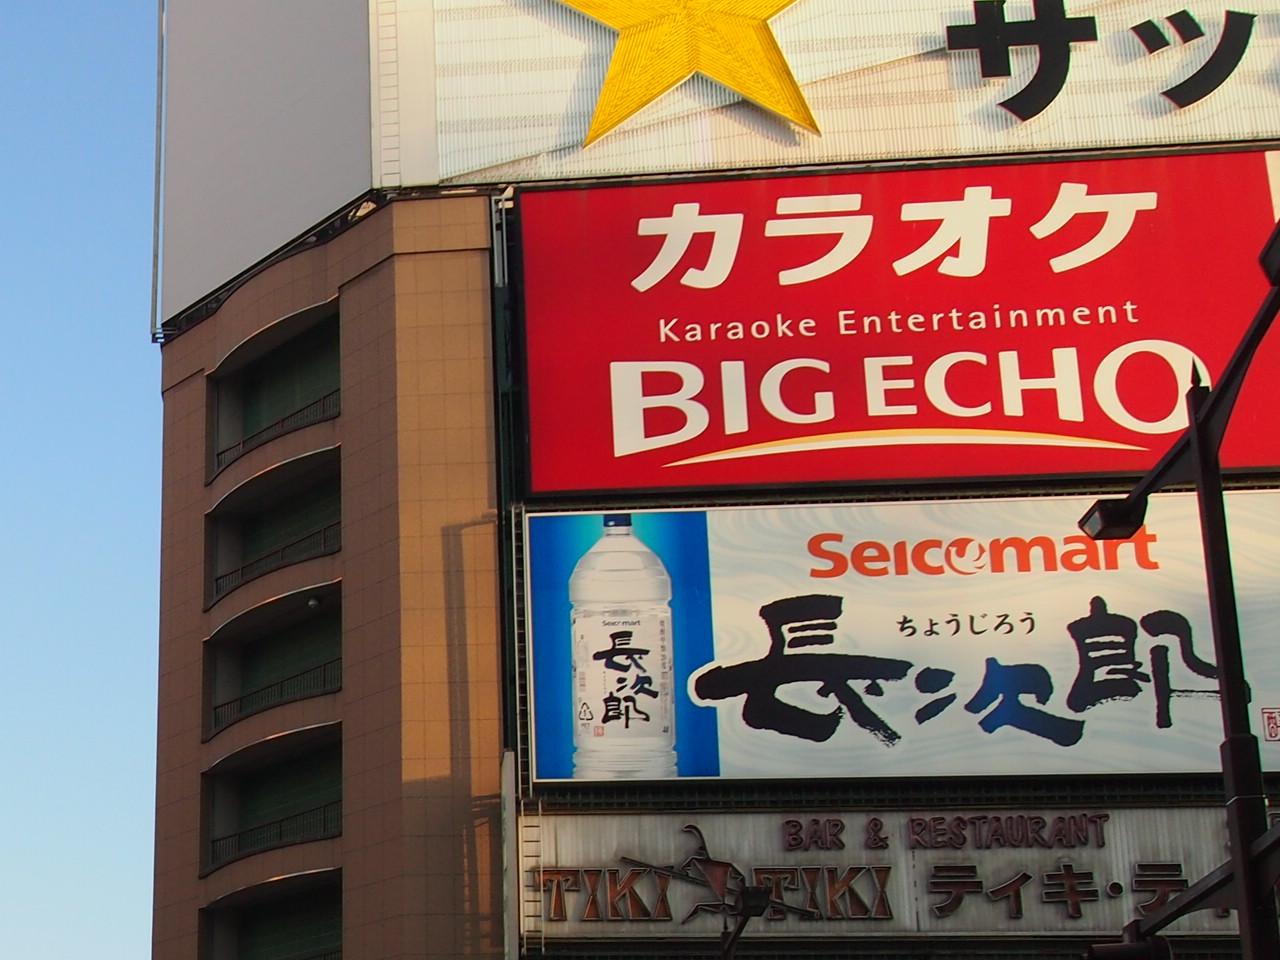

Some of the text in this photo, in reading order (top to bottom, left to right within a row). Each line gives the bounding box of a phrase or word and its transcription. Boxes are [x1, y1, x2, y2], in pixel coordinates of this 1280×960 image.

[630, 181, 1158, 292] カラオケ
[658, 300, 1140, 343] Karaoke Entertainment
[609, 339, 1212, 458] BIG ECHO
[896, 612, 1037, 638] ちょうじろう
[785, 814, 1110, 850] BAR & RESTAURANT
[535, 865, 893, 921] TIKI TIKI
